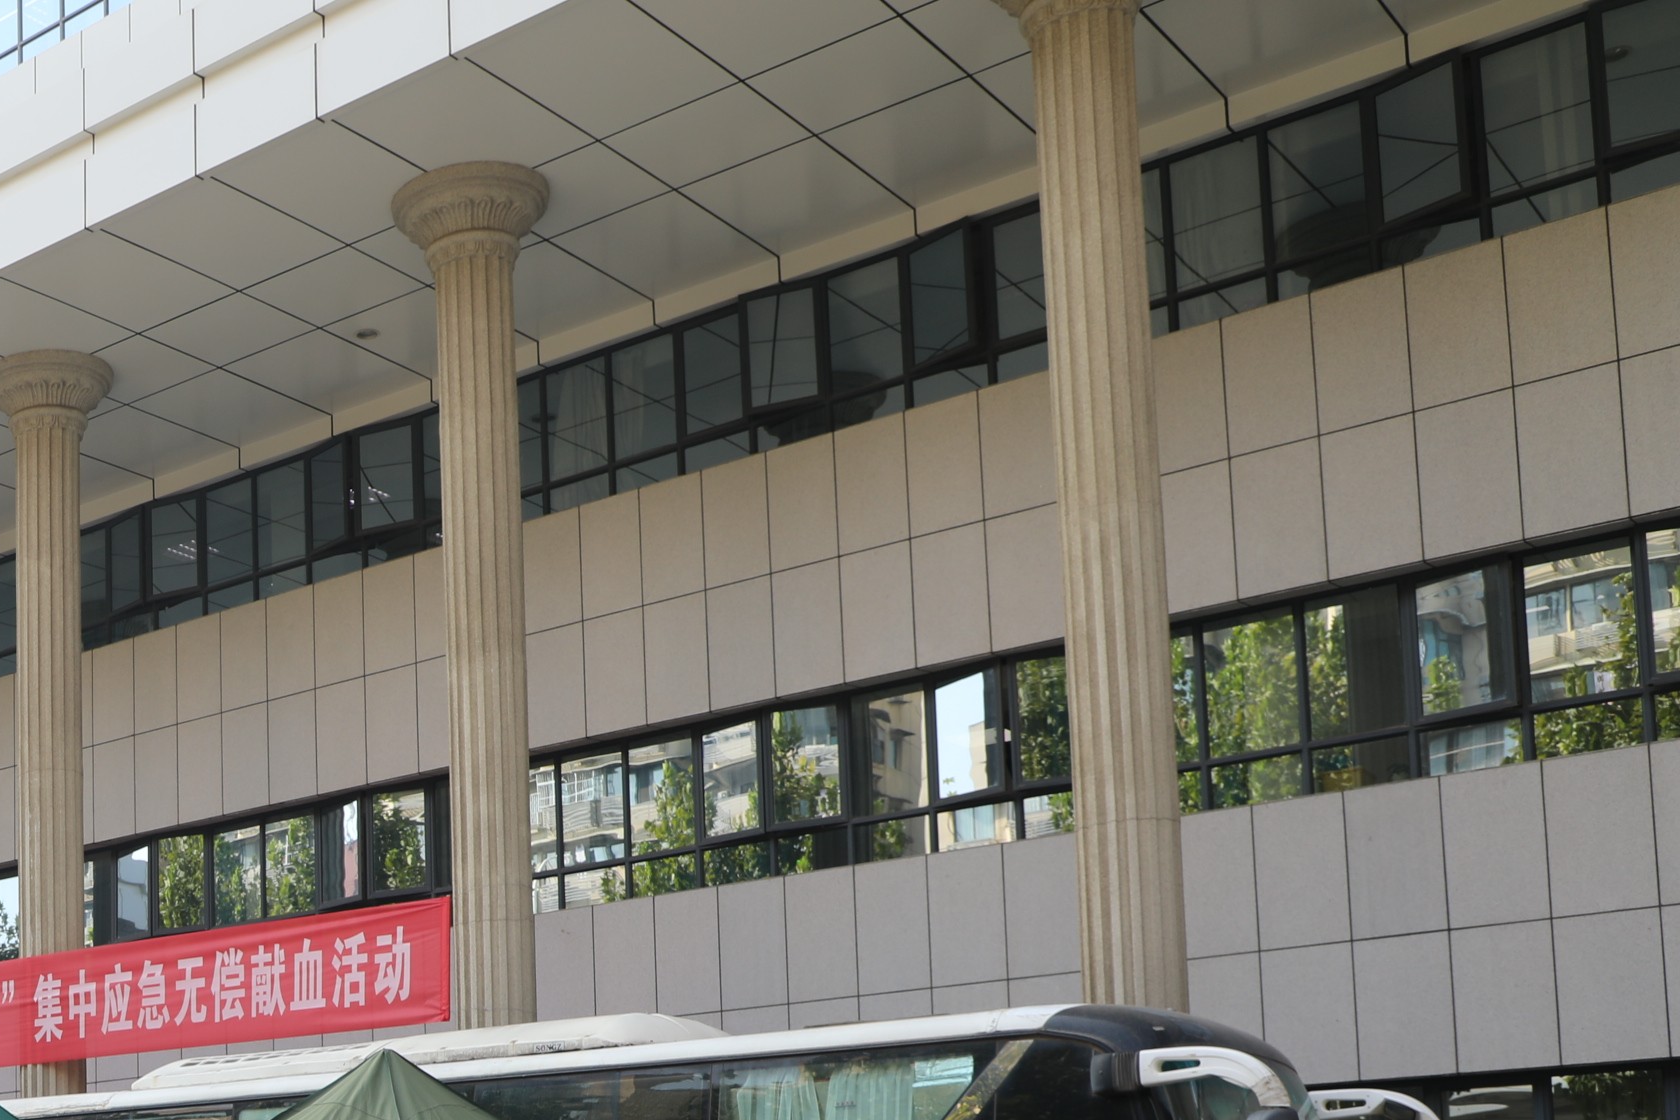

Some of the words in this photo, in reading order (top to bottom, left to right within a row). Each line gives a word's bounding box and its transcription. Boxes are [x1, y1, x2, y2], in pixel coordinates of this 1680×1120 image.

[33, 925, 412, 1043] 集中应急无偿献血活动
[535, 1043, 563, 1053] SONGZ
